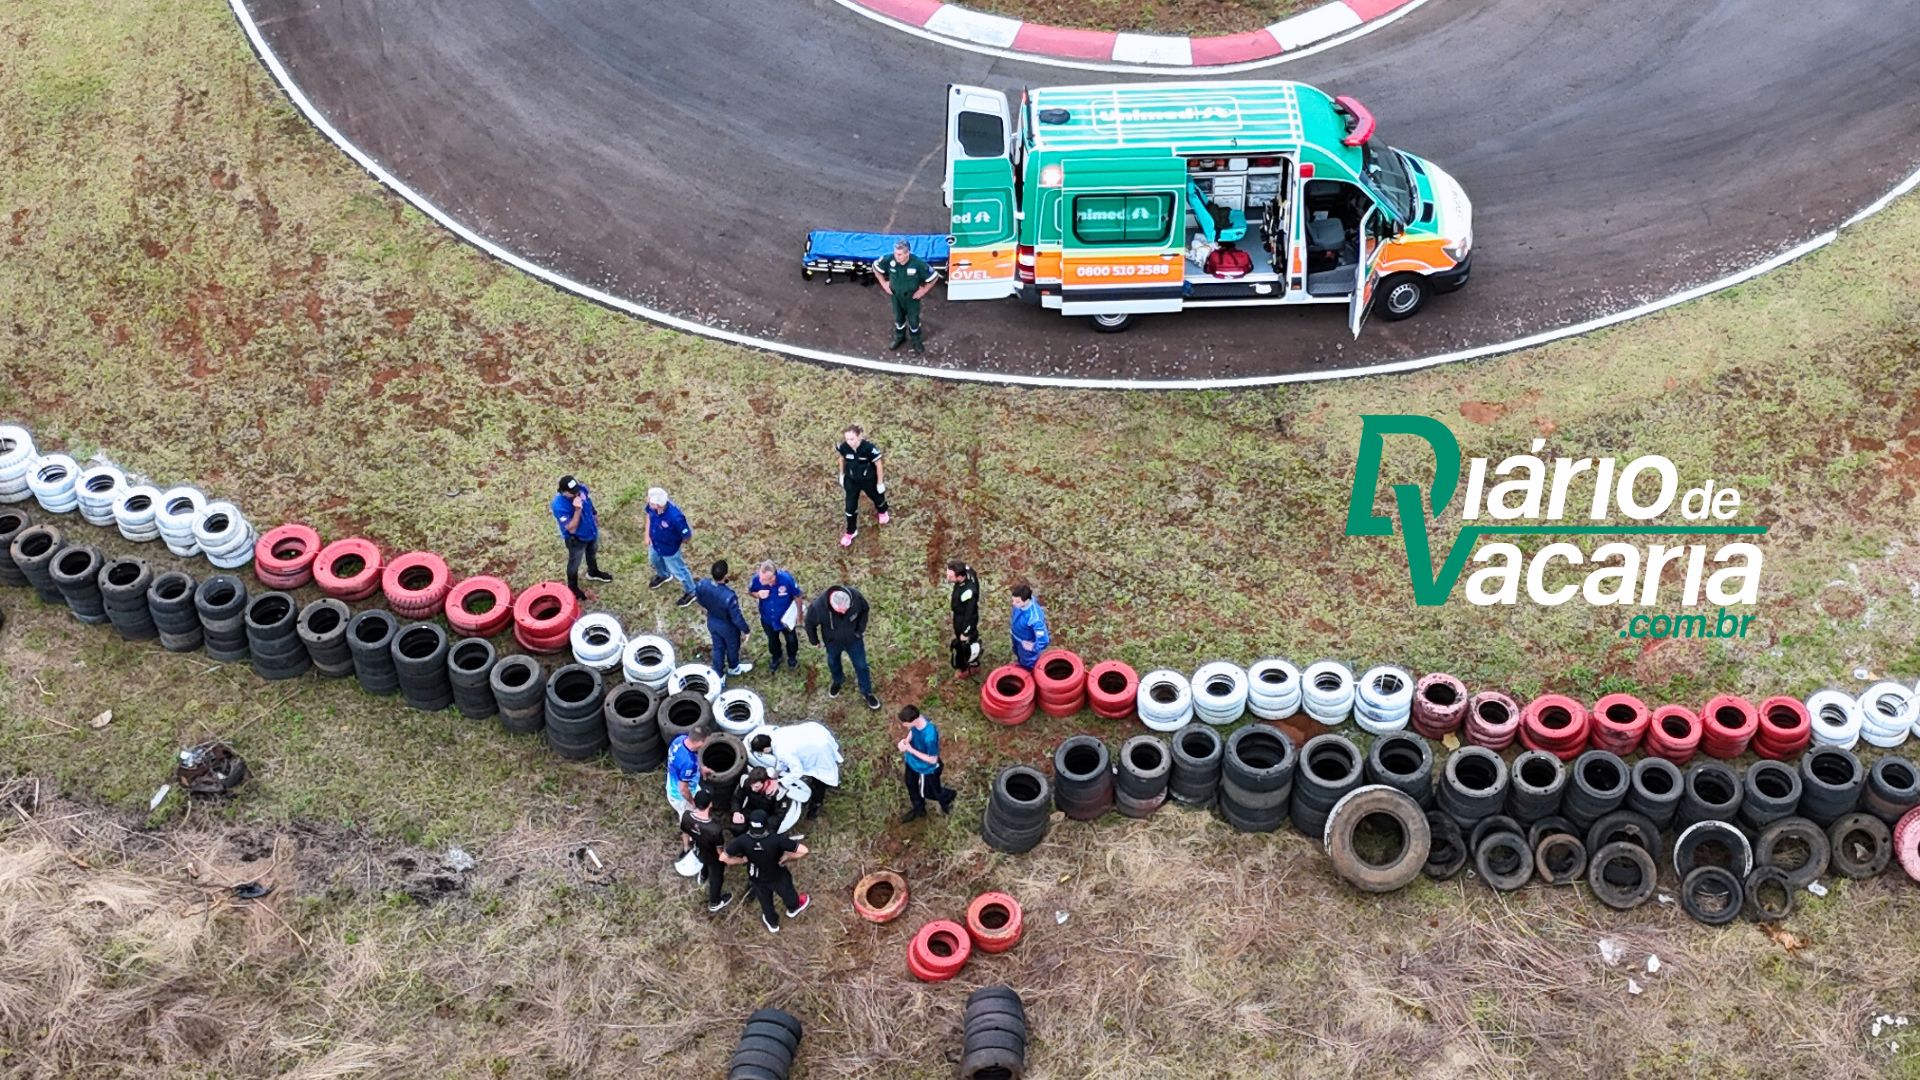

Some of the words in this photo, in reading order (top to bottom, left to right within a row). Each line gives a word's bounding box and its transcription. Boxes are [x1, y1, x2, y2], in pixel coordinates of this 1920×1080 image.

[1076, 266, 1111, 278] 0800
[1112, 265, 1136, 277] 510
[1136, 264, 1170, 276] 2588
